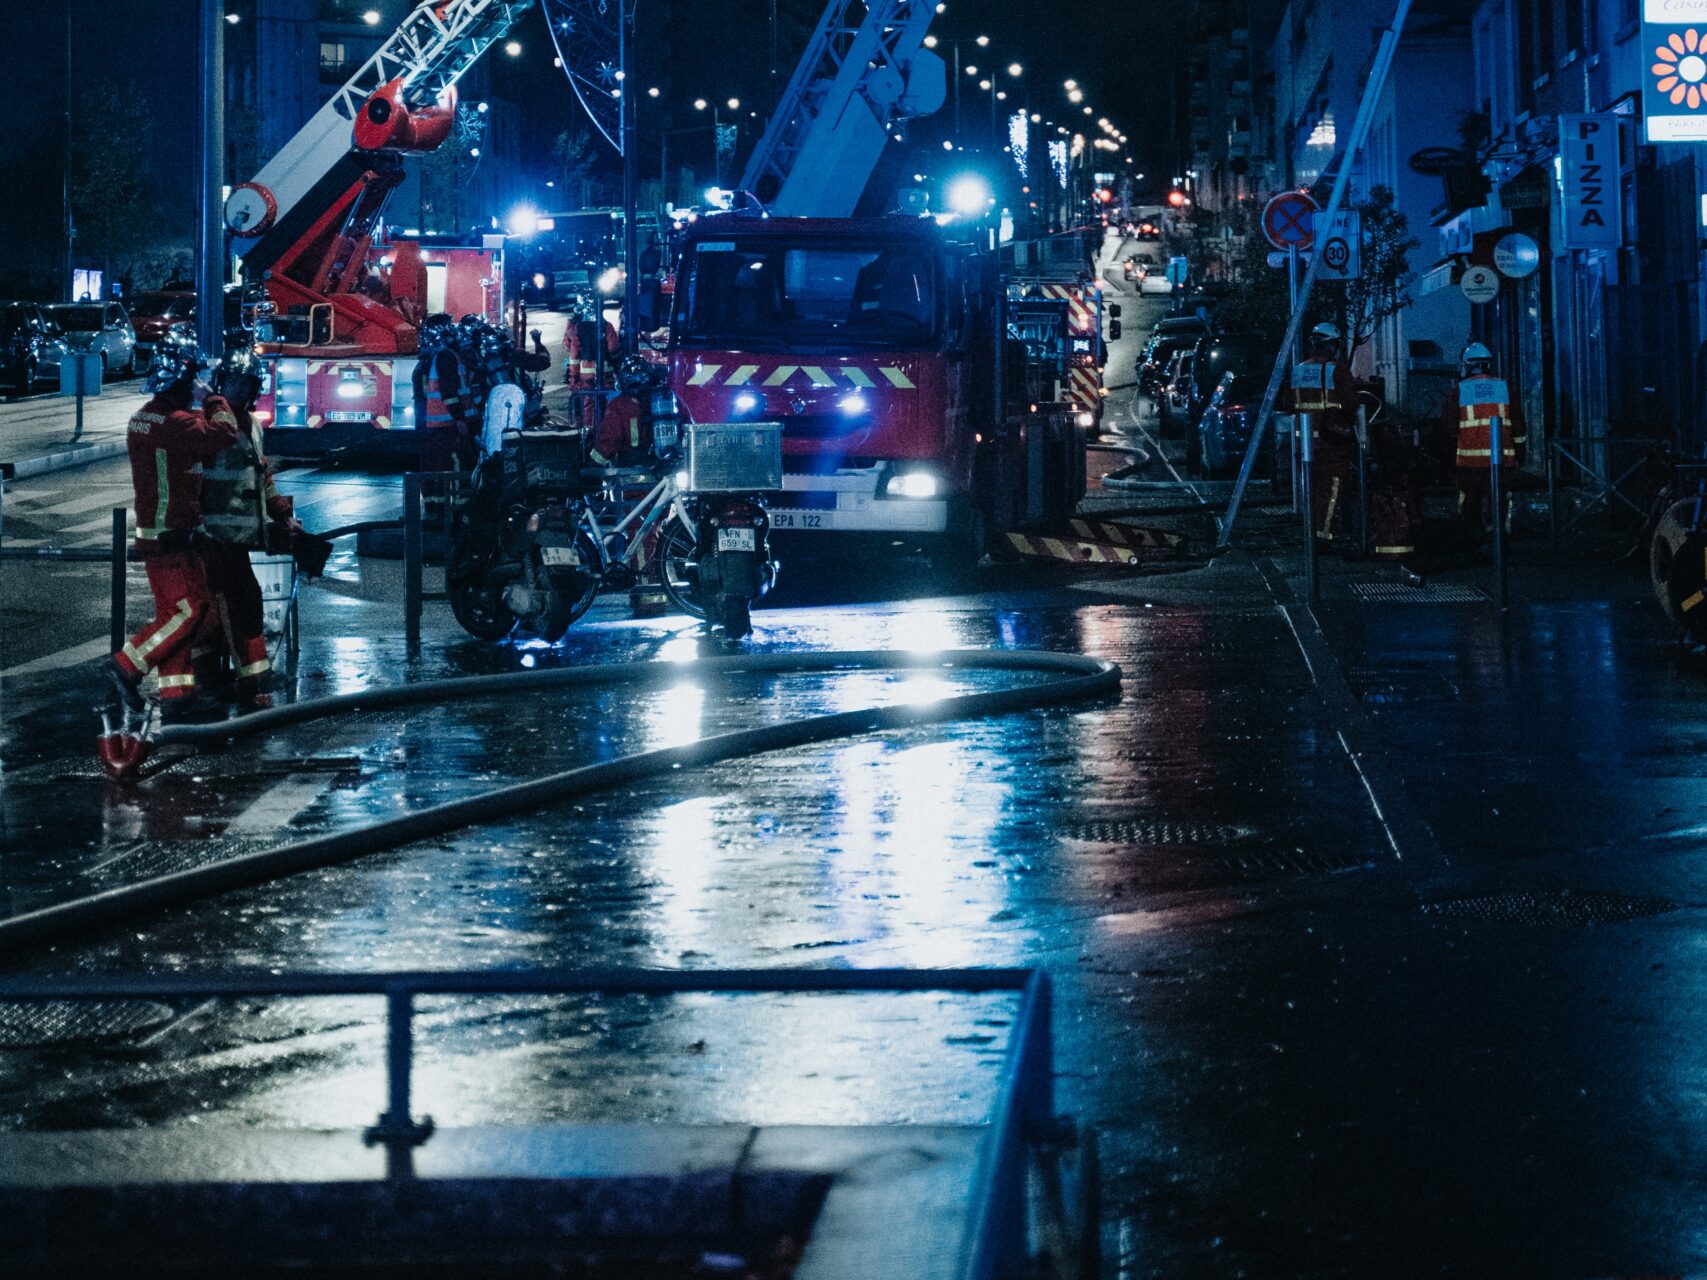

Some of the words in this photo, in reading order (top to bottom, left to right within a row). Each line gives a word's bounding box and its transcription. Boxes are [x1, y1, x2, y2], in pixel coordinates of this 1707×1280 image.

[1579, 121, 1605, 226] PIZZA
[1328, 247, 1345, 260] 30
[774, 515, 794, 527] EPA
[802, 516, 820, 527] 122
